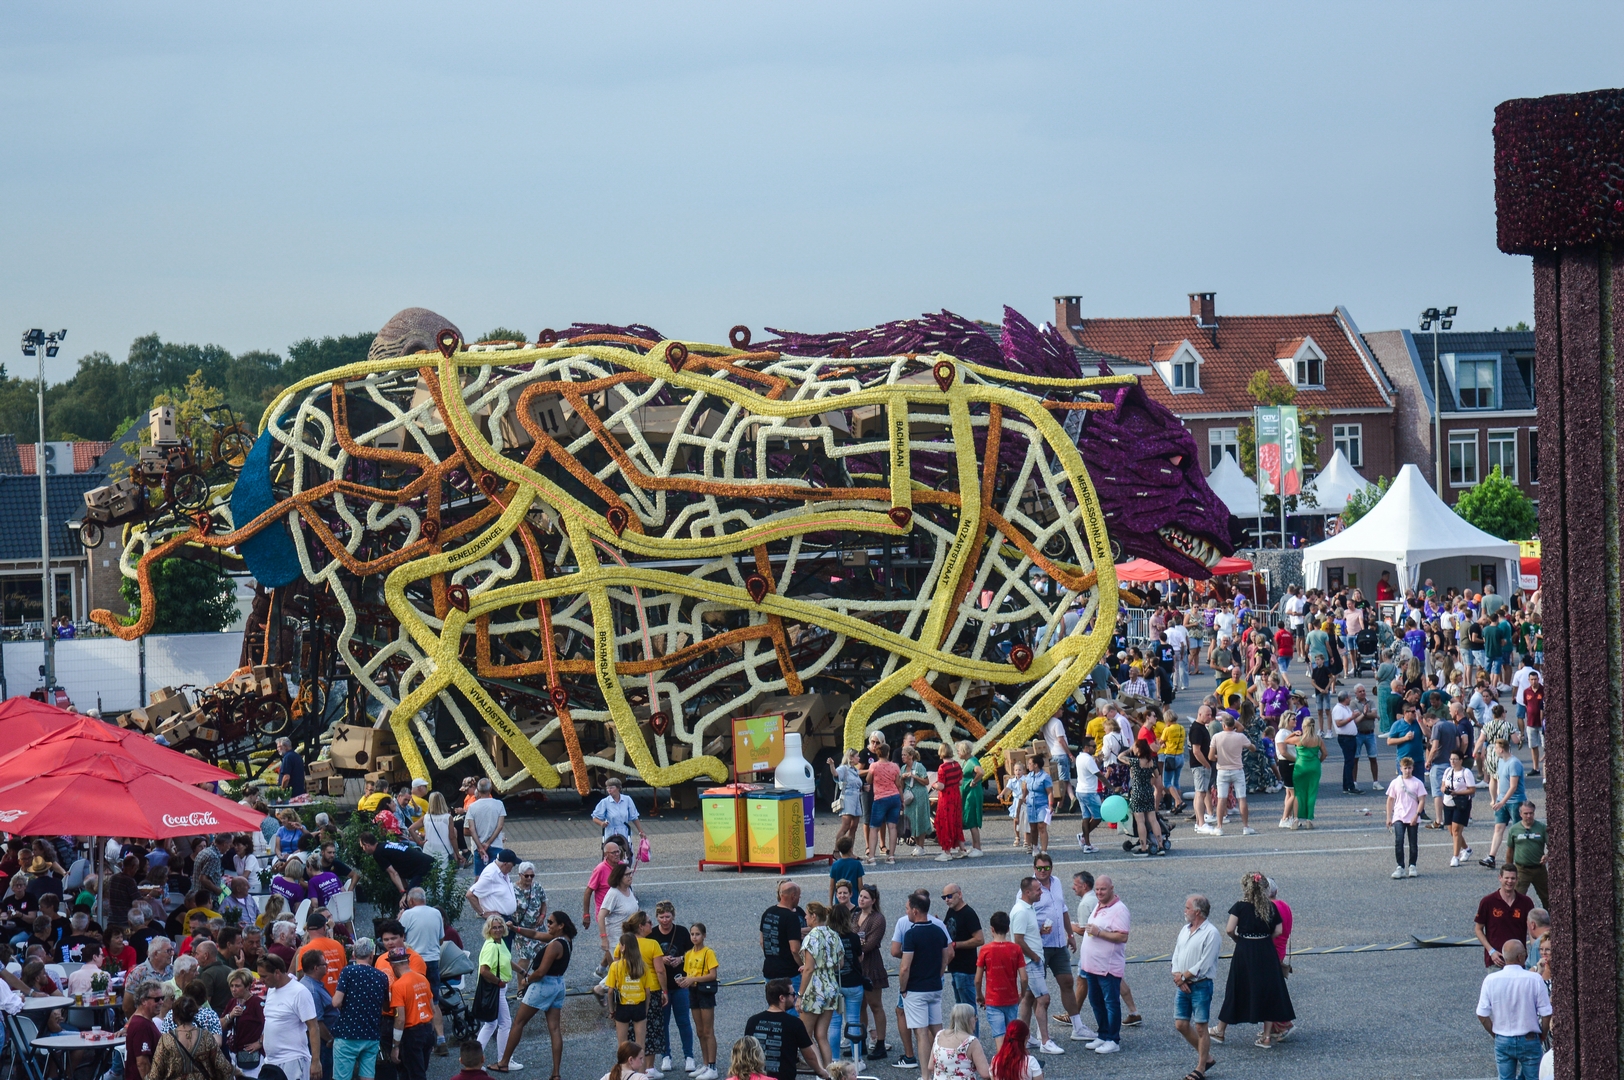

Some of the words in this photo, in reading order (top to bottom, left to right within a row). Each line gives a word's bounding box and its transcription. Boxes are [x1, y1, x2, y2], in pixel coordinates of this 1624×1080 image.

[896, 421, 905, 467] BACHLAAN
[1285, 426, 1295, 465] CLTV
[1076, 474, 1106, 559] MENDELSSOHNLAAN
[447, 526, 505, 564] BENELUXSINGEL
[941, 519, 972, 586] MOZARTSTRAAT
[599, 631, 614, 690] BRAHMSLAAN
[469, 687, 516, 738] VIVALDISTRAAT
[162, 811, 220, 828] Coca-Cola
